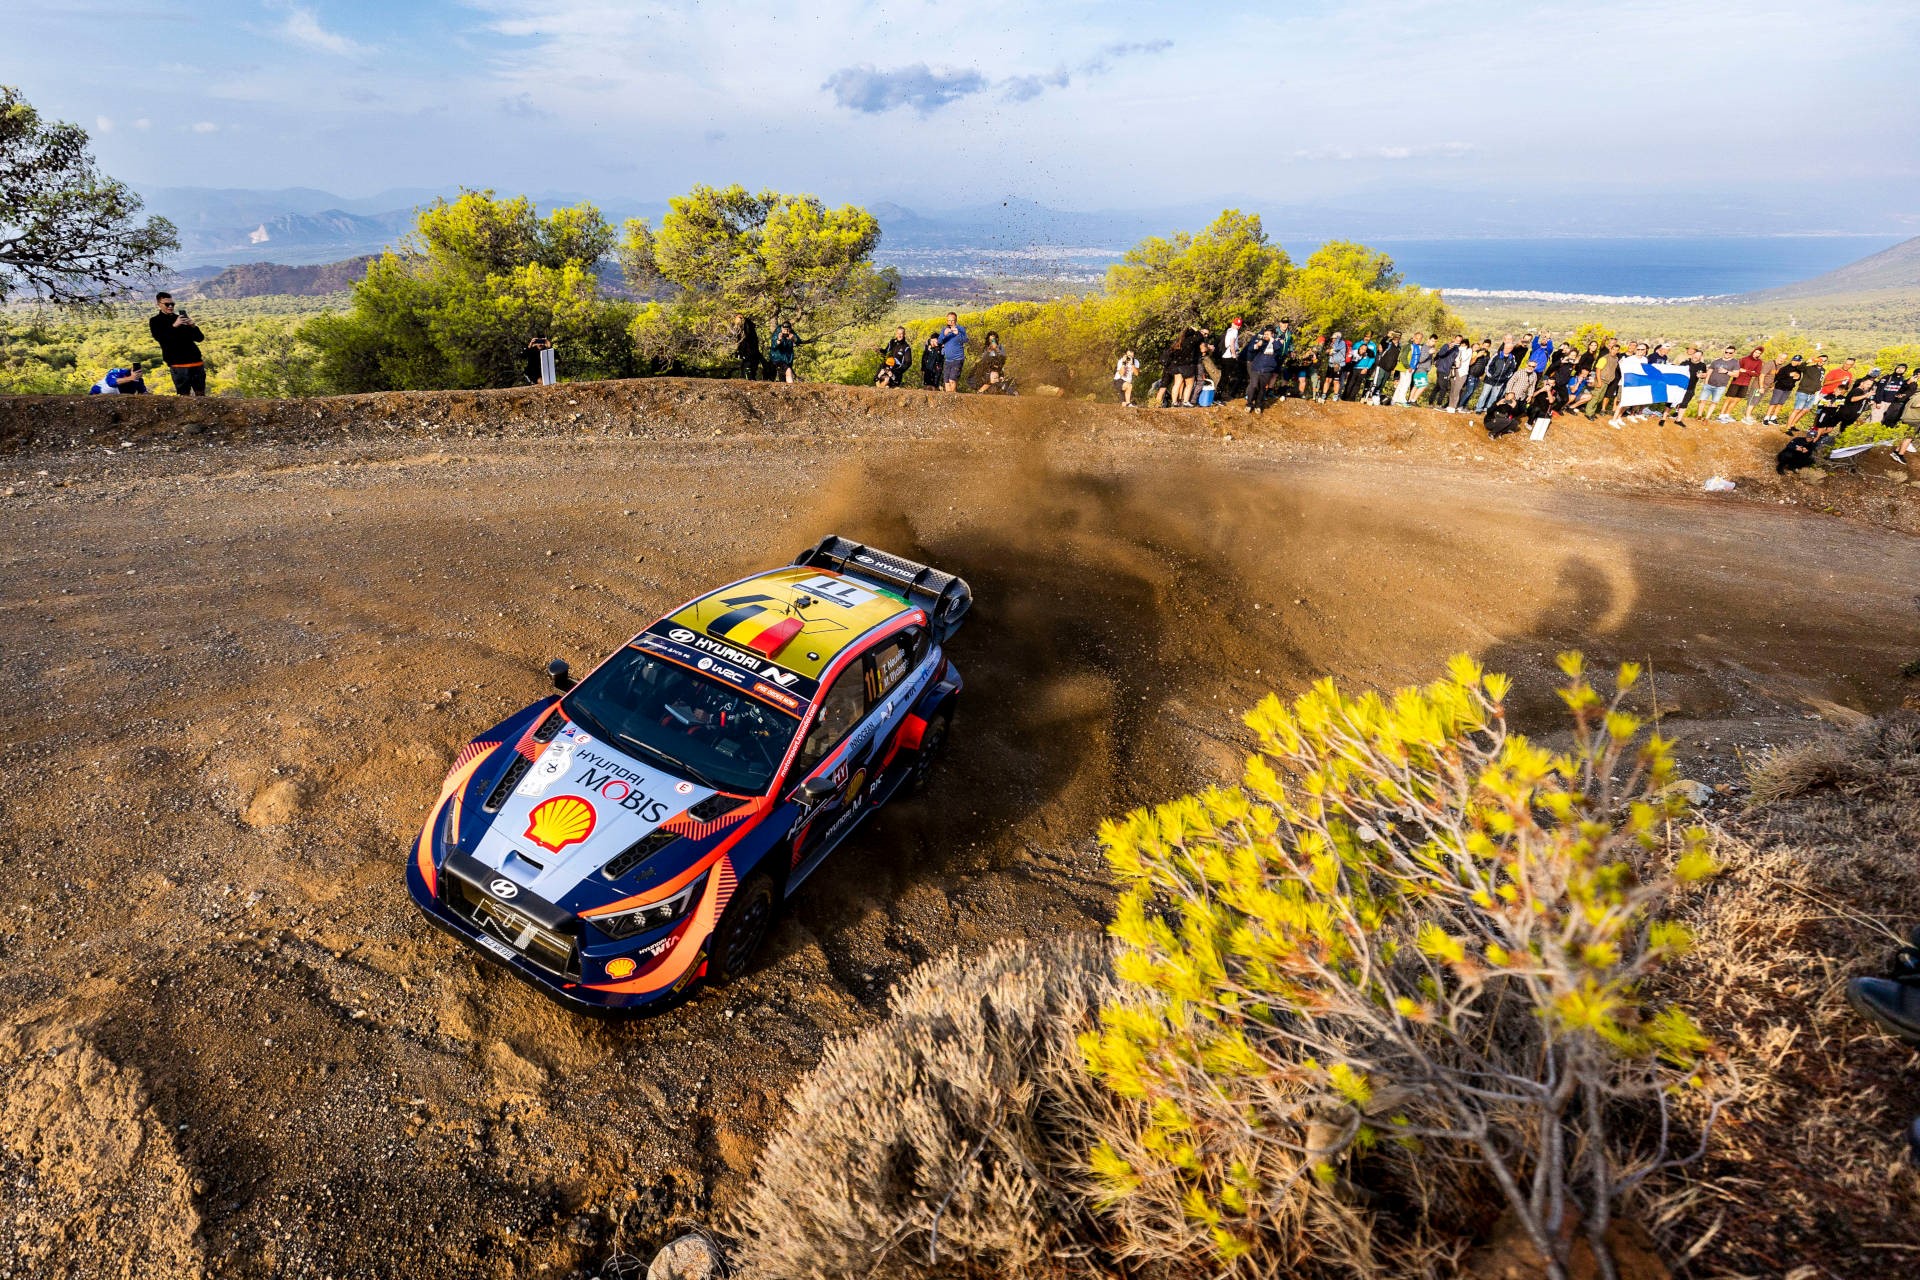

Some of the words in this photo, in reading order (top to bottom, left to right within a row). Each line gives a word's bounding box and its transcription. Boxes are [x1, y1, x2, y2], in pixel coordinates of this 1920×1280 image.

[875, 561, 917, 579] HYUNDA
[817, 581, 858, 598] 11
[695, 637, 762, 670] HYUNDAI
[758, 666, 800, 688] N
[711, 663, 746, 683] WRC
[865, 667, 877, 702] 11
[578, 734, 588, 743] E
[781, 704, 818, 778] motorsport.hyundai.com
[576, 749, 645, 786] HYUNDAI
[575, 767, 669, 823] MOBIS
[679, 783, 689, 791] E
[639, 938, 667, 954] HYUNDAI
